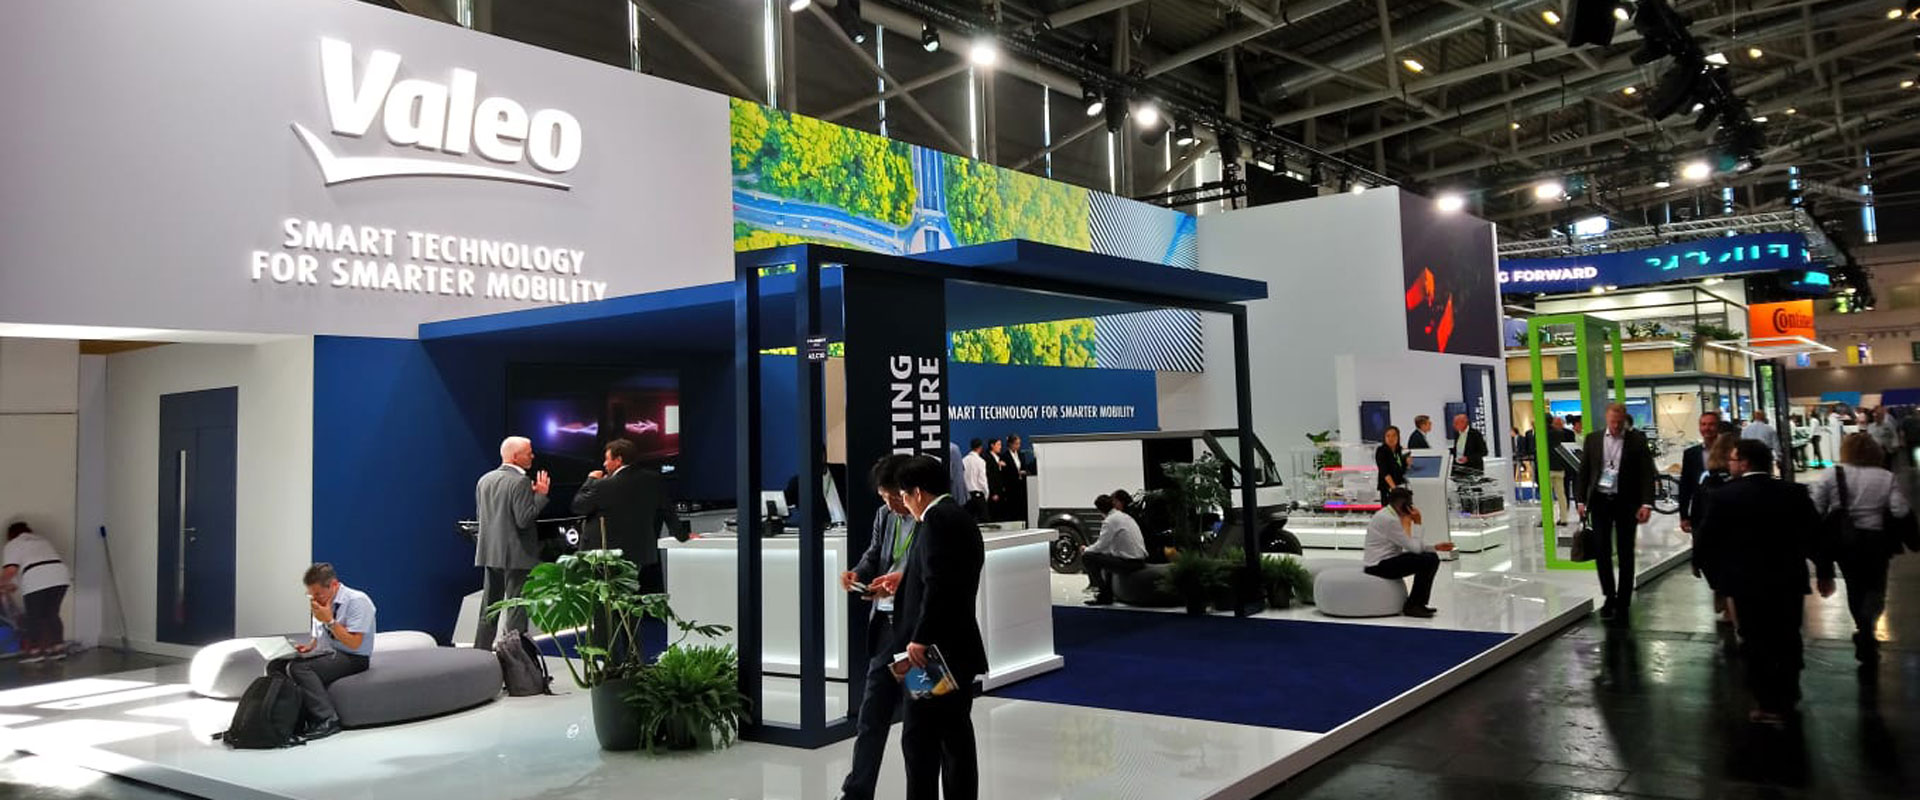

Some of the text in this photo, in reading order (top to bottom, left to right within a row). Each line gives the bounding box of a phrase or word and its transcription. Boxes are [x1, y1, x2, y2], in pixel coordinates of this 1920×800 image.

[320, 37, 582, 173] Valeo
[282, 217, 585, 275] SMART TECHNOLOGY
[251, 251, 607, 303] FOR SMARTER MOBILITY
[1513, 266, 1598, 282] FORWARD
[918, 357, 942, 462] HERE
[948, 405, 1135, 420] MART TECHNOLOGY FOR SMARTER MOBILITY
